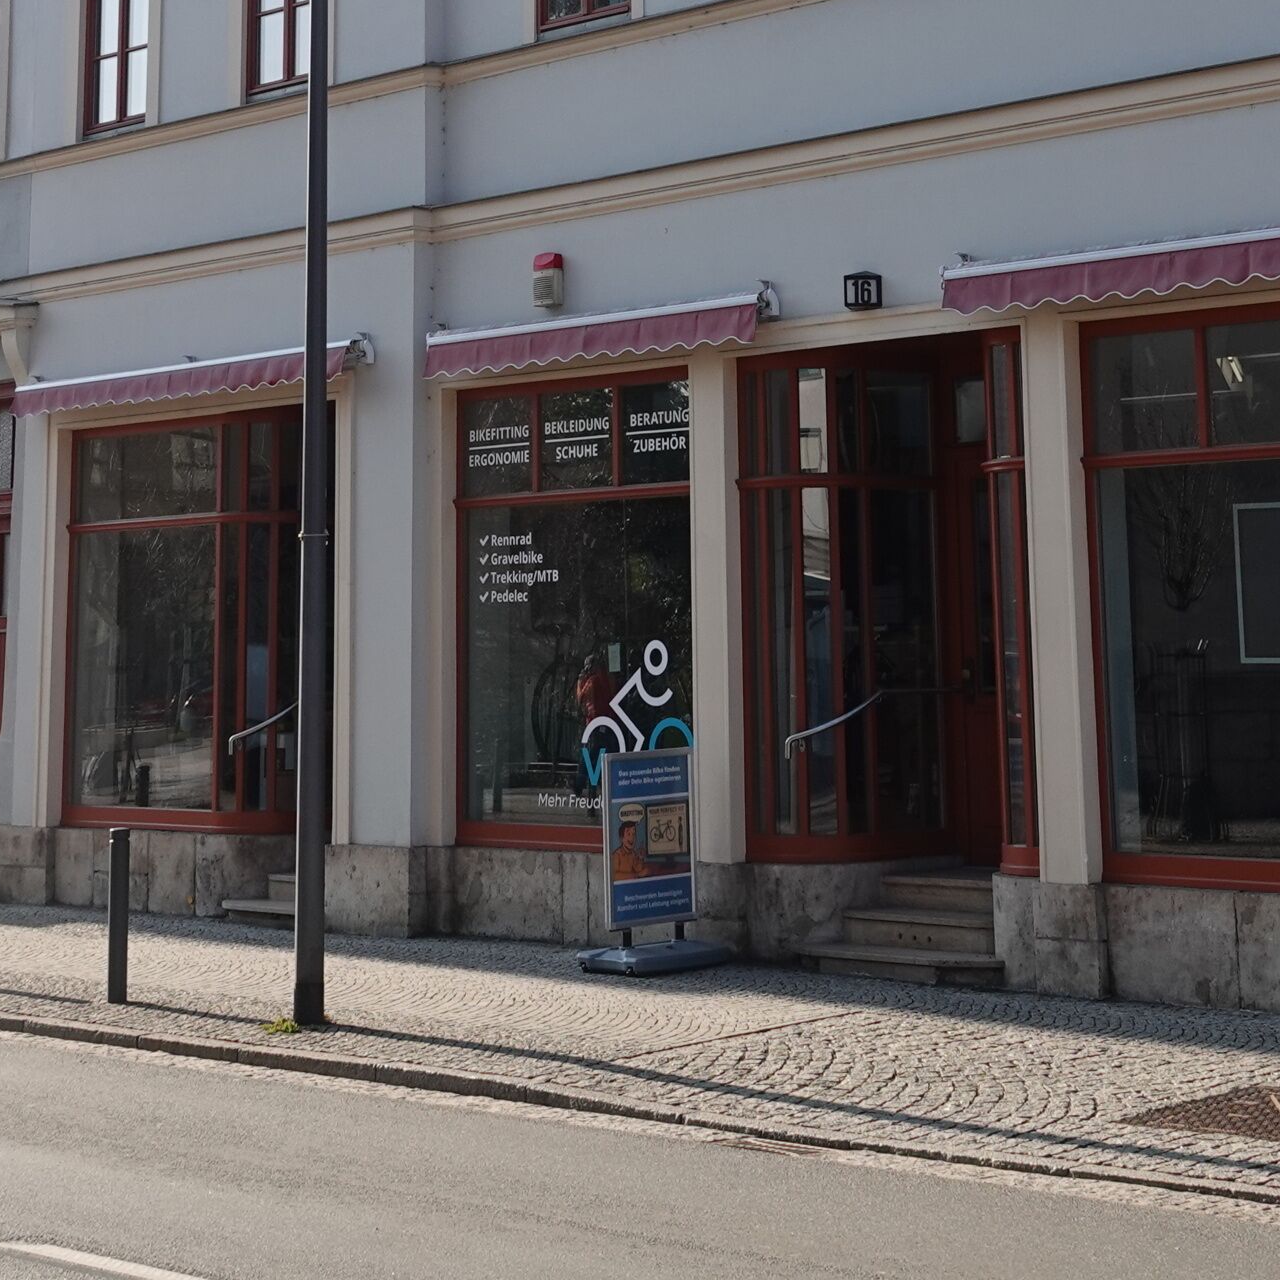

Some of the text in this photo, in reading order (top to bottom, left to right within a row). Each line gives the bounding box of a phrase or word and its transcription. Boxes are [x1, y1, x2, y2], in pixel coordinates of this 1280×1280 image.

[851, 280, 872, 304] 16
[544, 416, 610, 435] BEKLEIDUNG
[629, 408, 689, 427] BERATUNG
[469, 425, 530, 443] BIKEFITTING
[632, 434, 687, 453] ZUBEHÖR
[469, 450, 530, 468] ERGONOMIE
[555, 444, 599, 460] SCHUHE
[490, 532, 532, 546] Rennrad
[490, 551, 543, 565] Gravelbike
[490, 569, 559, 586] Trekking/MTB
[490, 589, 528, 603] Pedelec
[629, 768, 652, 777] passende
[654, 775, 682, 784] optimieren
[538, 793, 567, 807] Mehr
[617, 903, 638, 912] Komfort
[648, 900, 670, 908] Leistung
